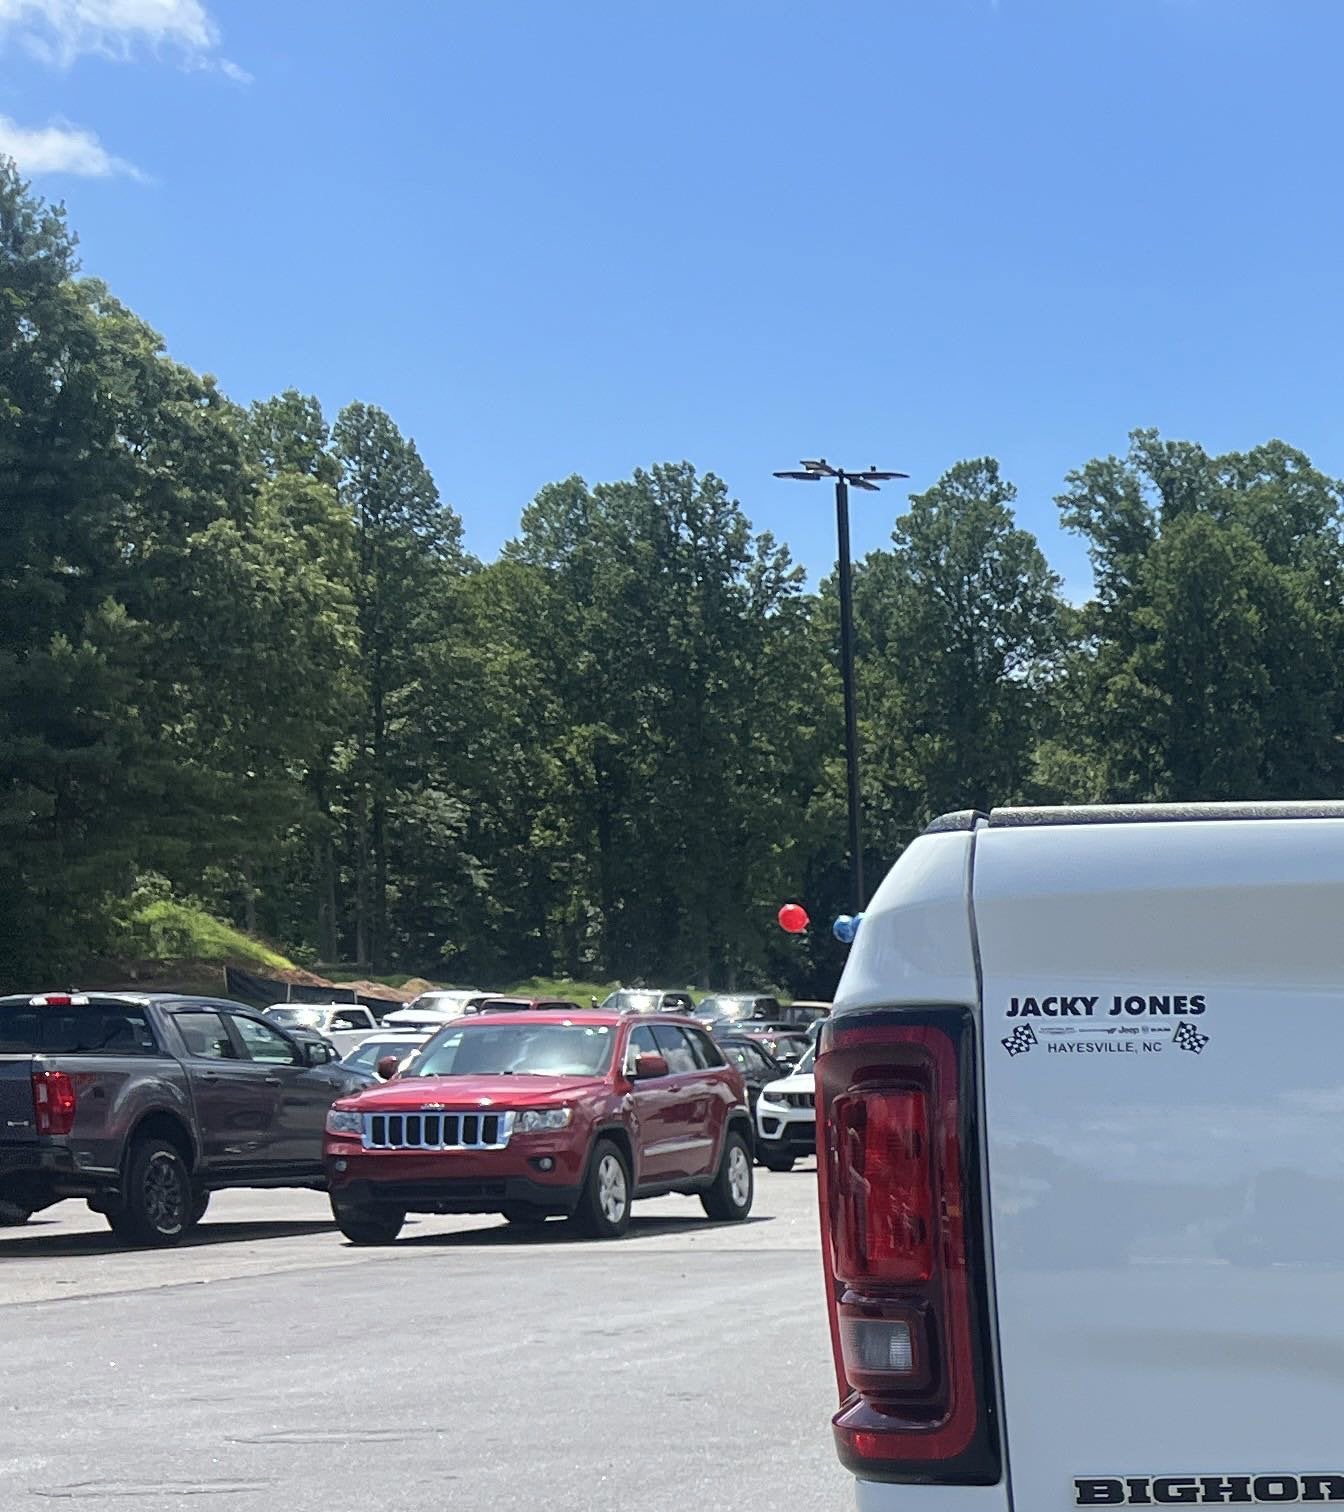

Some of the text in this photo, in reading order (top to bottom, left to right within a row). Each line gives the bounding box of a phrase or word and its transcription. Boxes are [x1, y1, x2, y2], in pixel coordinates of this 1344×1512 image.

[1006, 995, 1206, 1018] JACKY JONES
[1047, 1042, 1162, 1054] HAYESVILLE, NC
